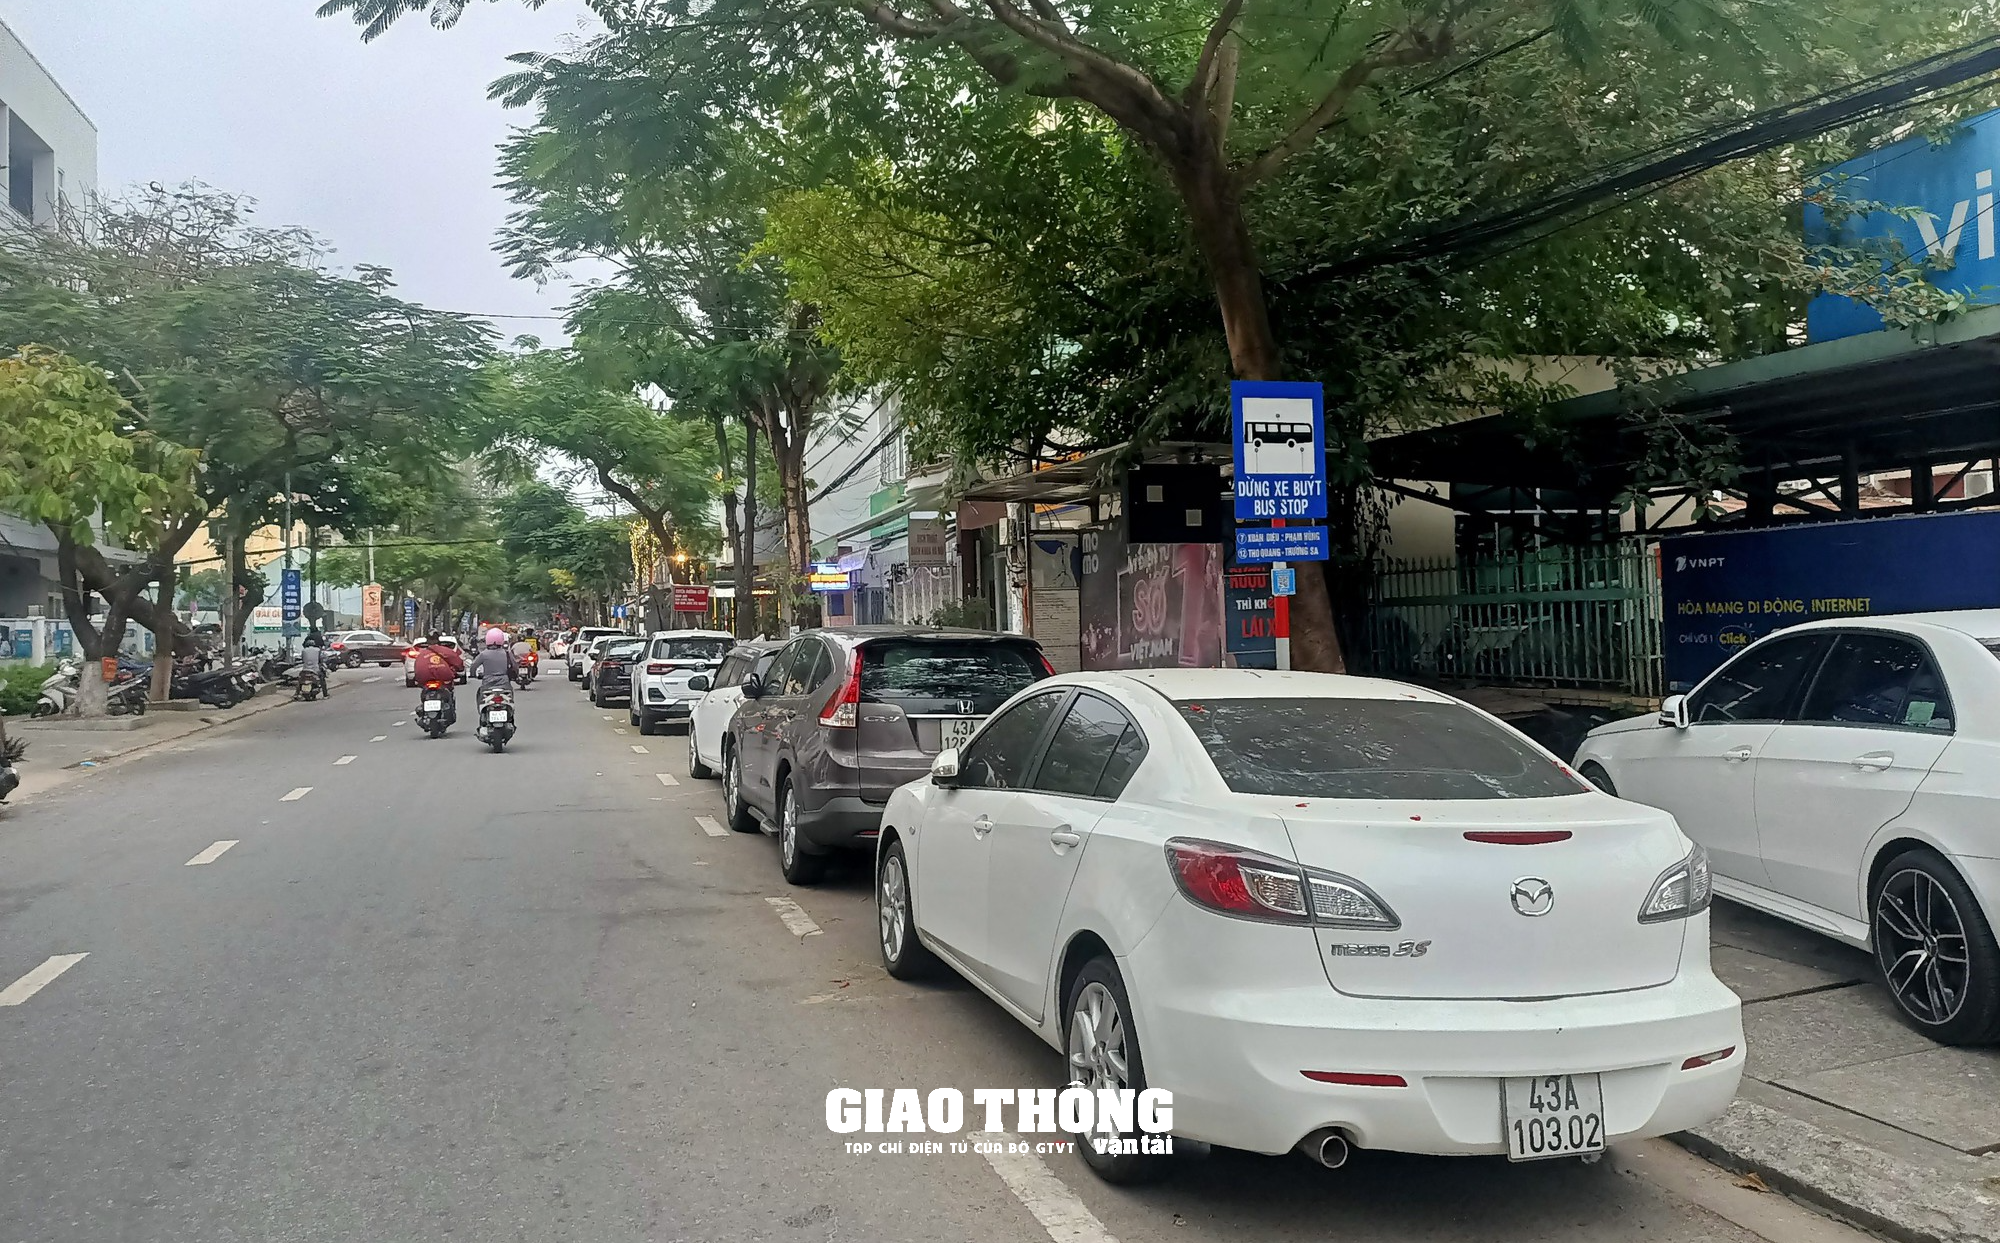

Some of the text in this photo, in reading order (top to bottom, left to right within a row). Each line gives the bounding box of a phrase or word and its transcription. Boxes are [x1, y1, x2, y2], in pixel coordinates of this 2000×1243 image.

[1238, 474, 1322, 497] DỪNG XE BUÝT
[1254, 498, 1309, 515] BUS STOP
[1689, 558, 1725, 568] VNPT
[1236, 597, 1252, 610] THÌ
[1678, 600, 1702, 614] HÒA
[1706, 602, 1744, 617] MẠNG
[1748, 601, 1760, 613] DI
[1811, 598, 1870, 612] INTERNET
[1242, 614, 1275, 638] LÁI X
[953, 720, 976, 736] 43A
[1529, 1074, 1580, 1113] 43A
[1514, 1113, 1602, 1155] 103.02
